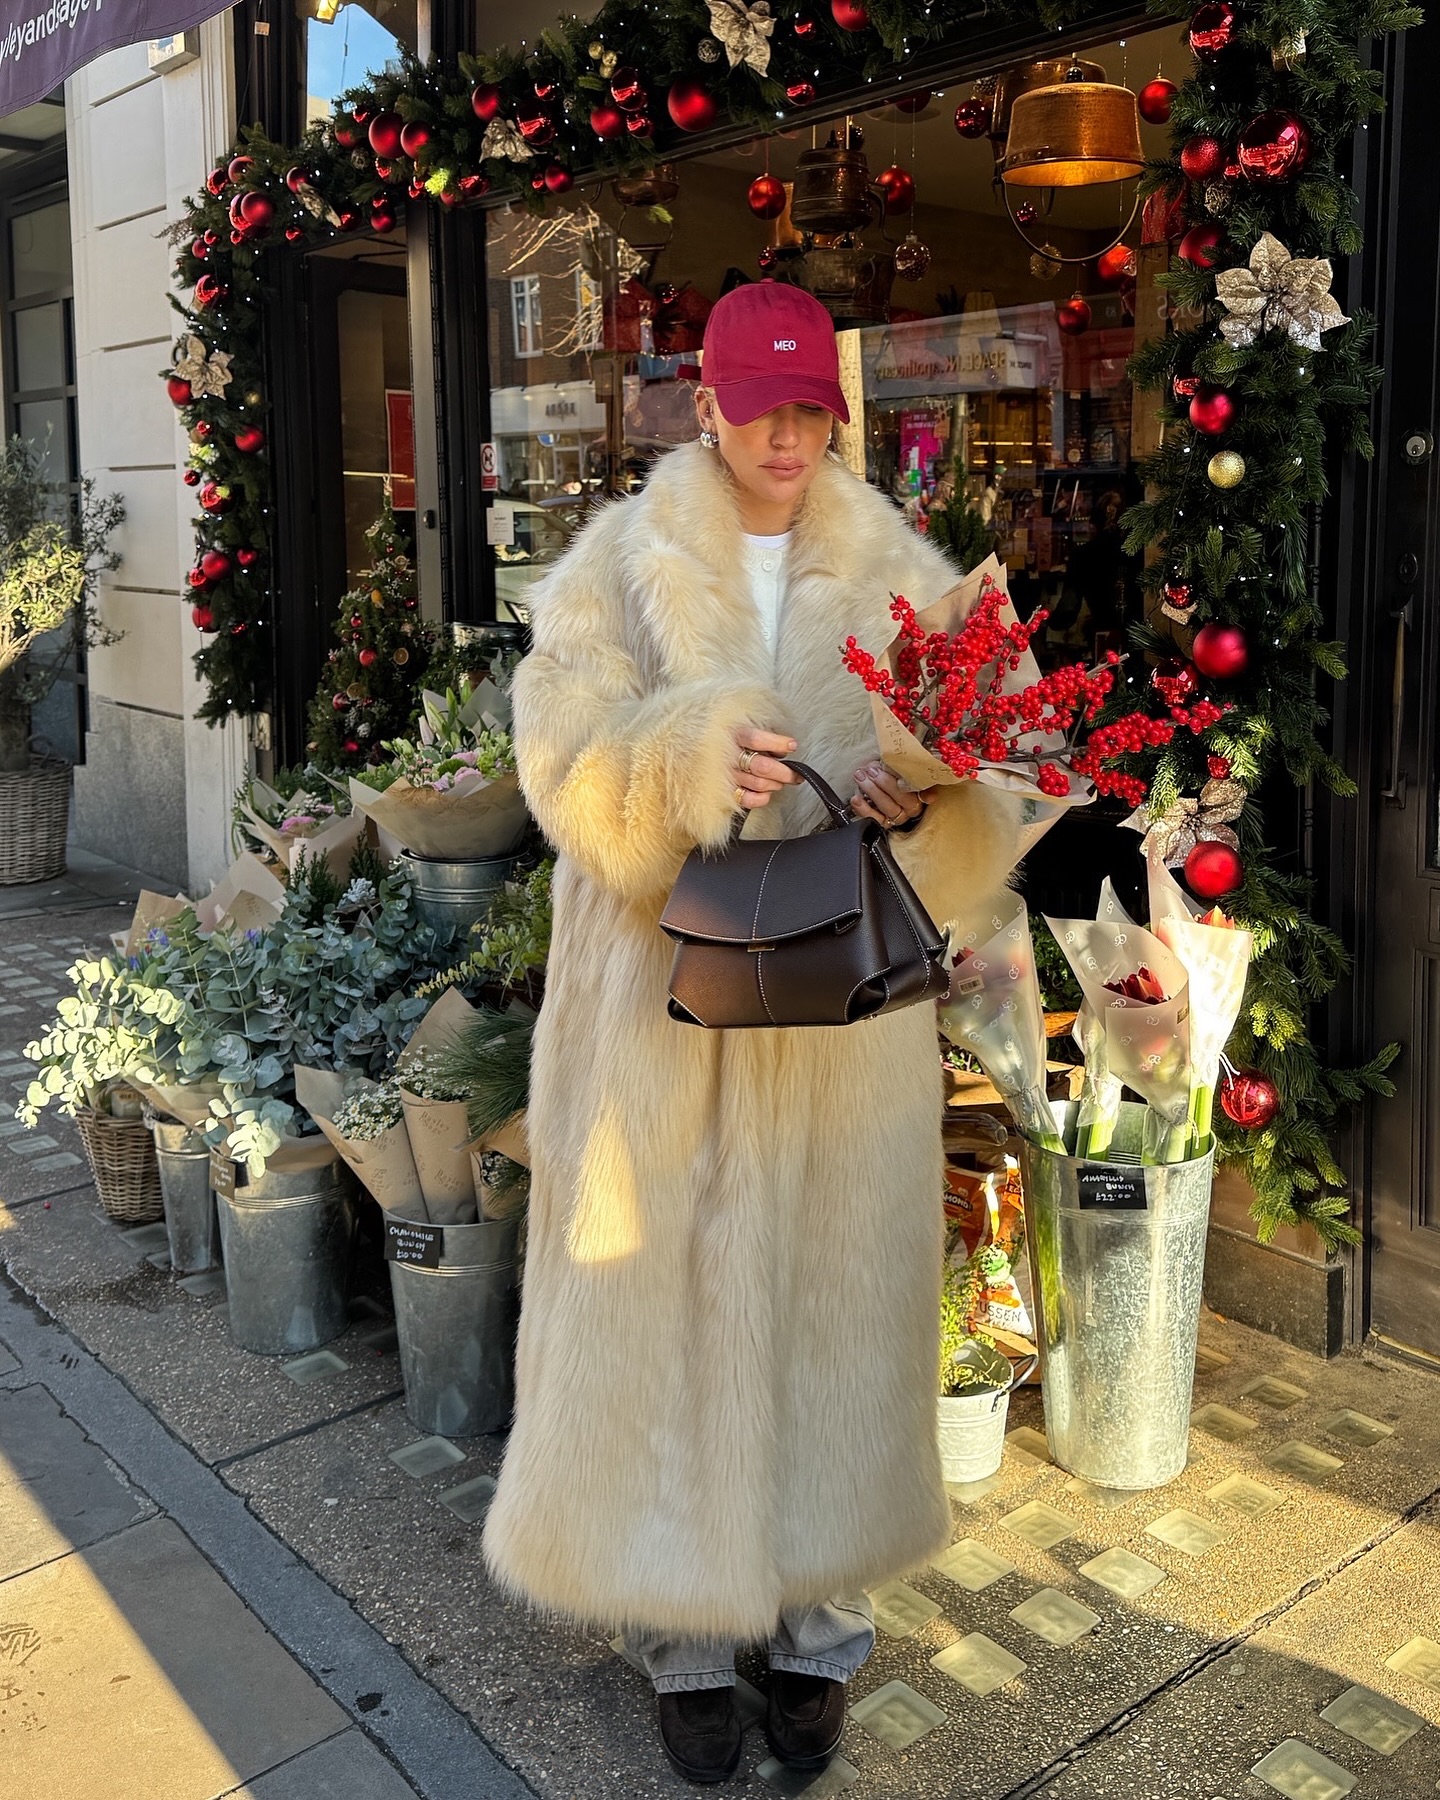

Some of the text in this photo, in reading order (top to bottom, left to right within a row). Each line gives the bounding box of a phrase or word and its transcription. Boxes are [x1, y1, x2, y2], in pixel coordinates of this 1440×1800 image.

[773, 340, 797, 352] MEO
[1106, 1183, 1135, 1192] BUNCH
[396, 1238, 426, 1252] BUNCH
